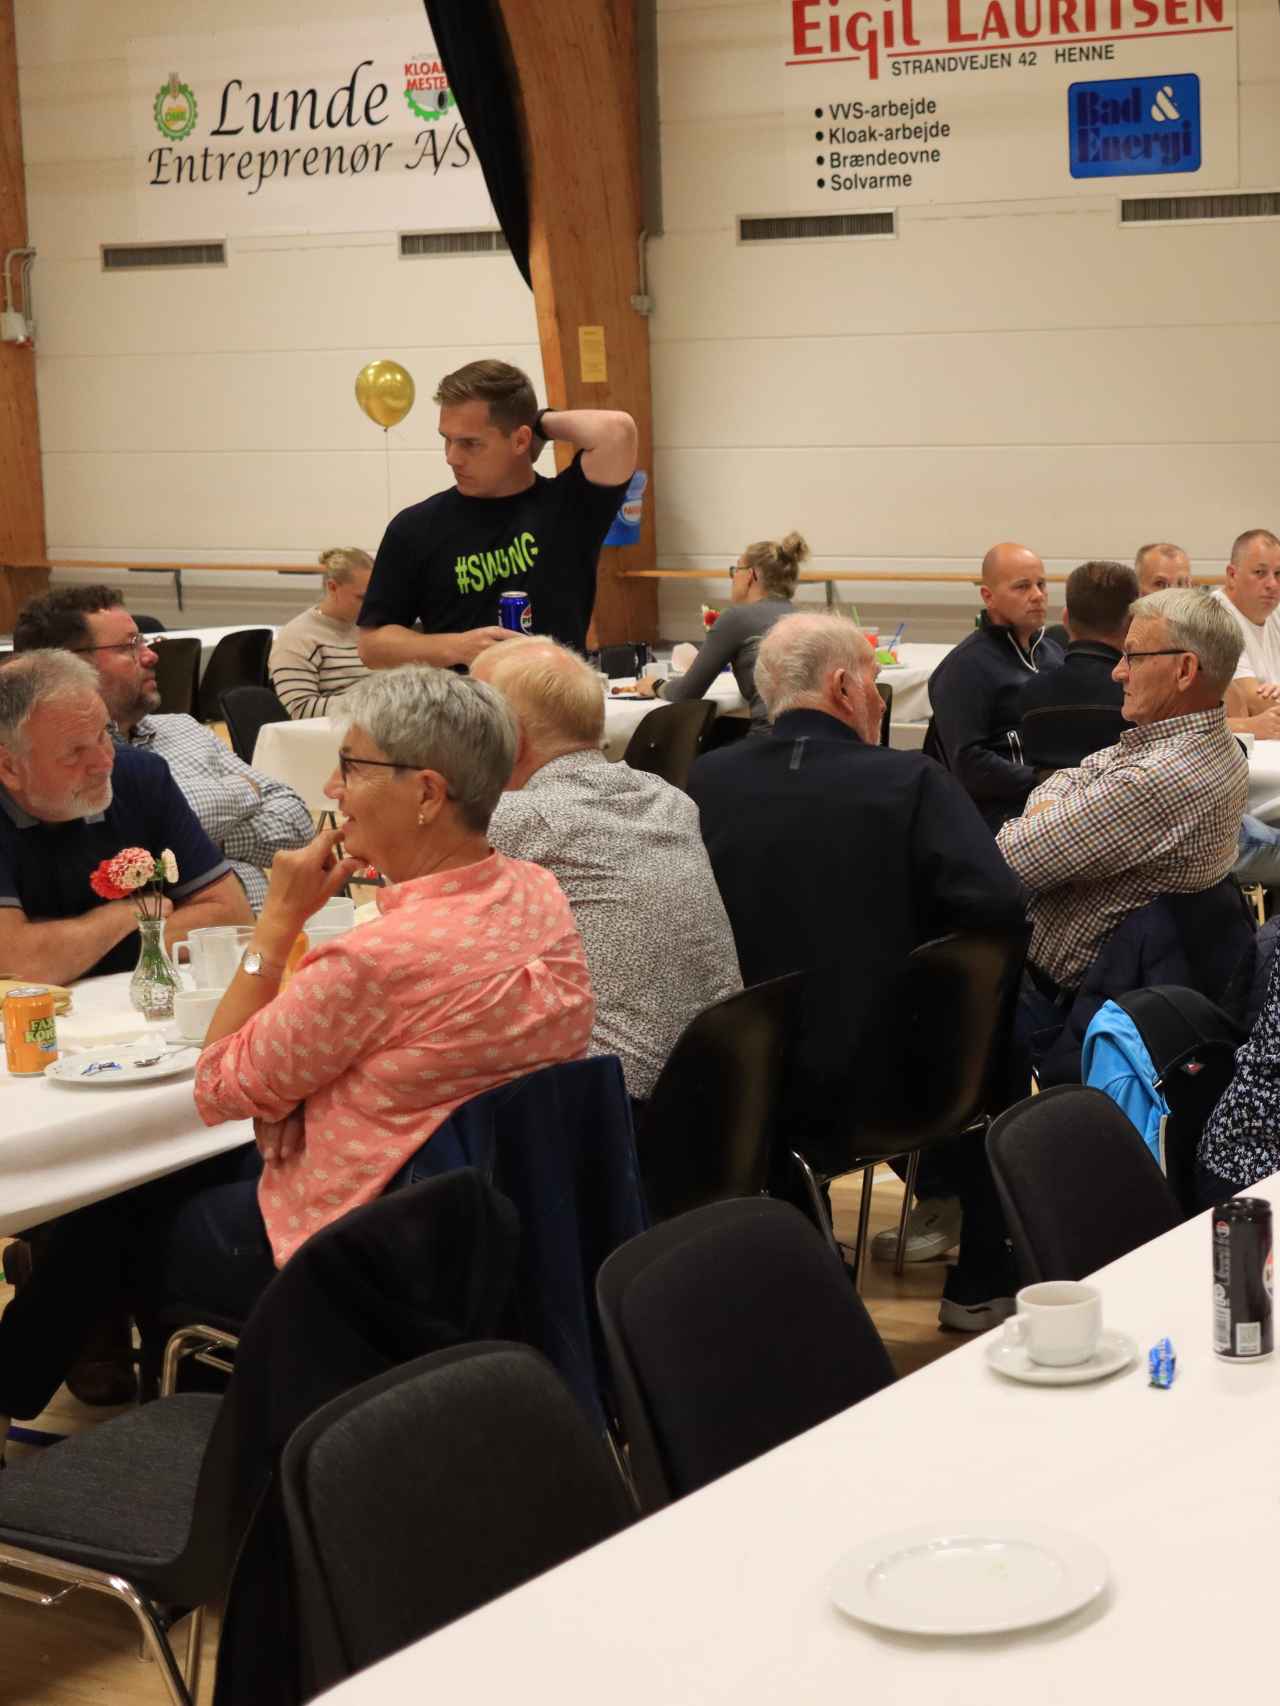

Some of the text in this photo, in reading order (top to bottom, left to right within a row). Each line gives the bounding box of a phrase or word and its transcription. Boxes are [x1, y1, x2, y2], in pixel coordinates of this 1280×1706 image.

[792, 0, 921, 80] Eigil
[404, 61, 444, 76] KLOA
[891, 44, 1116, 77] STRANDVEJEN 42 HENNE
[210, 59, 390, 137] Lunde
[405, 76, 448, 91] MESTE
[828, 96, 938, 121] VVS-arbejde
[1076, 85, 1180, 127] Bad &
[828, 119, 952, 145] Kloak-arbejde
[1076, 119, 1194, 168] Energi
[147, 122, 471, 196] Entreprenør A/S
[829, 147, 942, 170] Brændeovne
[830, 171, 913, 192] Solvarme
